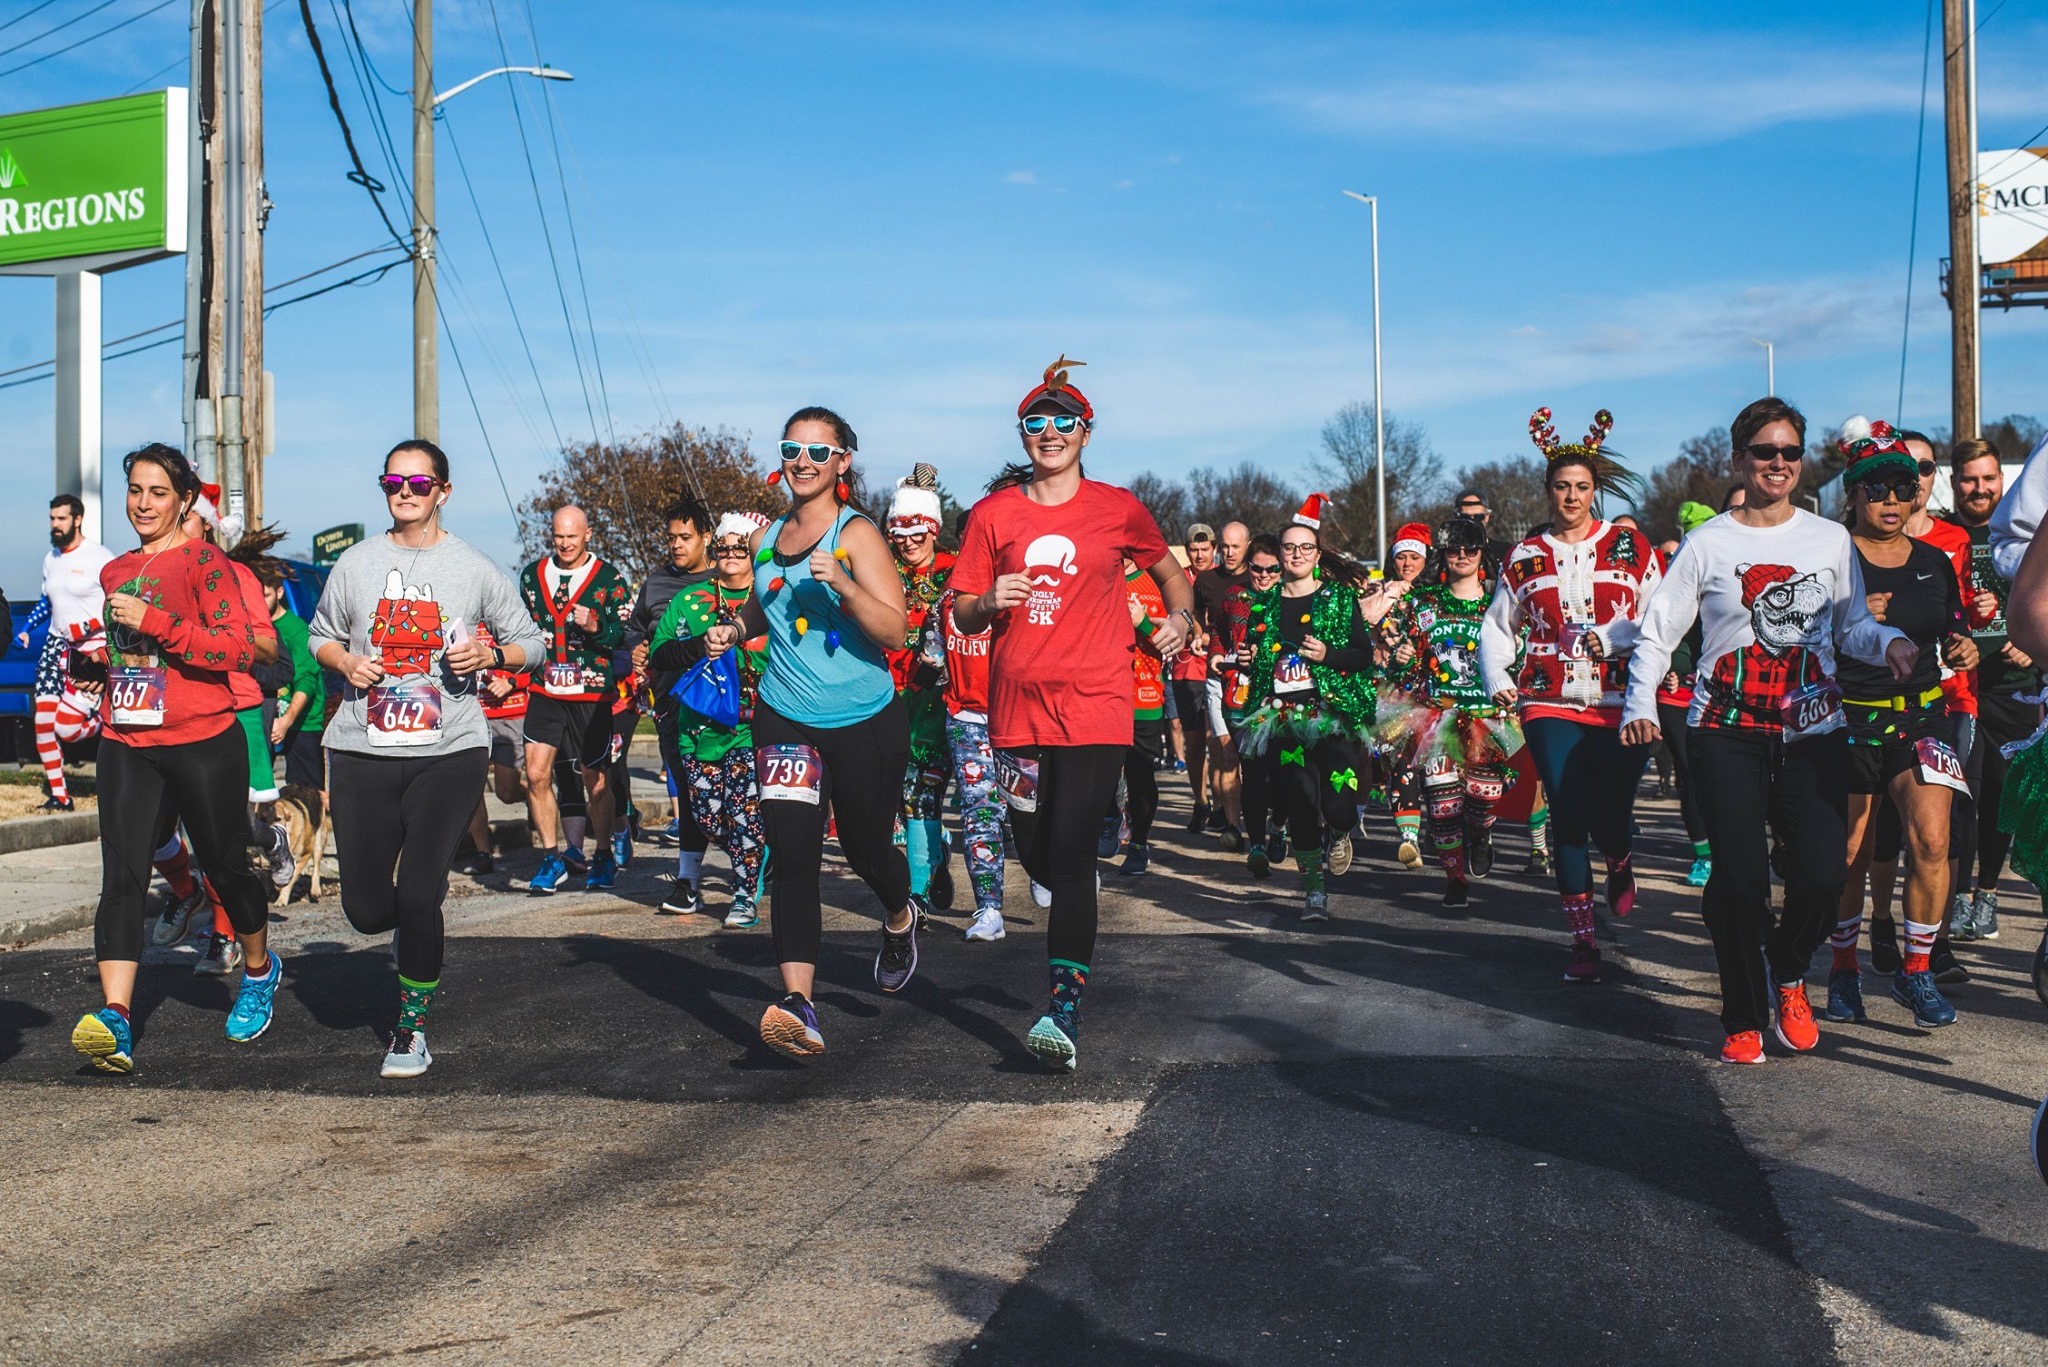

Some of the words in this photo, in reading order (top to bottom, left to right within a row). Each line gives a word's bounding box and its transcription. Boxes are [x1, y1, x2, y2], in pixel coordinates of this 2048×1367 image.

[0, 187, 145, 236] REGIONS
[316, 530, 344, 547] DOWN
[325, 537, 354, 553] UNDER
[1032, 591, 1056, 599] UGLY
[1028, 610, 1054, 625] 5K
[552, 670, 575, 686] 718
[1282, 663, 1309, 681] 704
[112, 681, 148, 708] 667
[384, 701, 425, 729] 642
[767, 759, 808, 784] 739
[1933, 749, 1963, 779] 730
